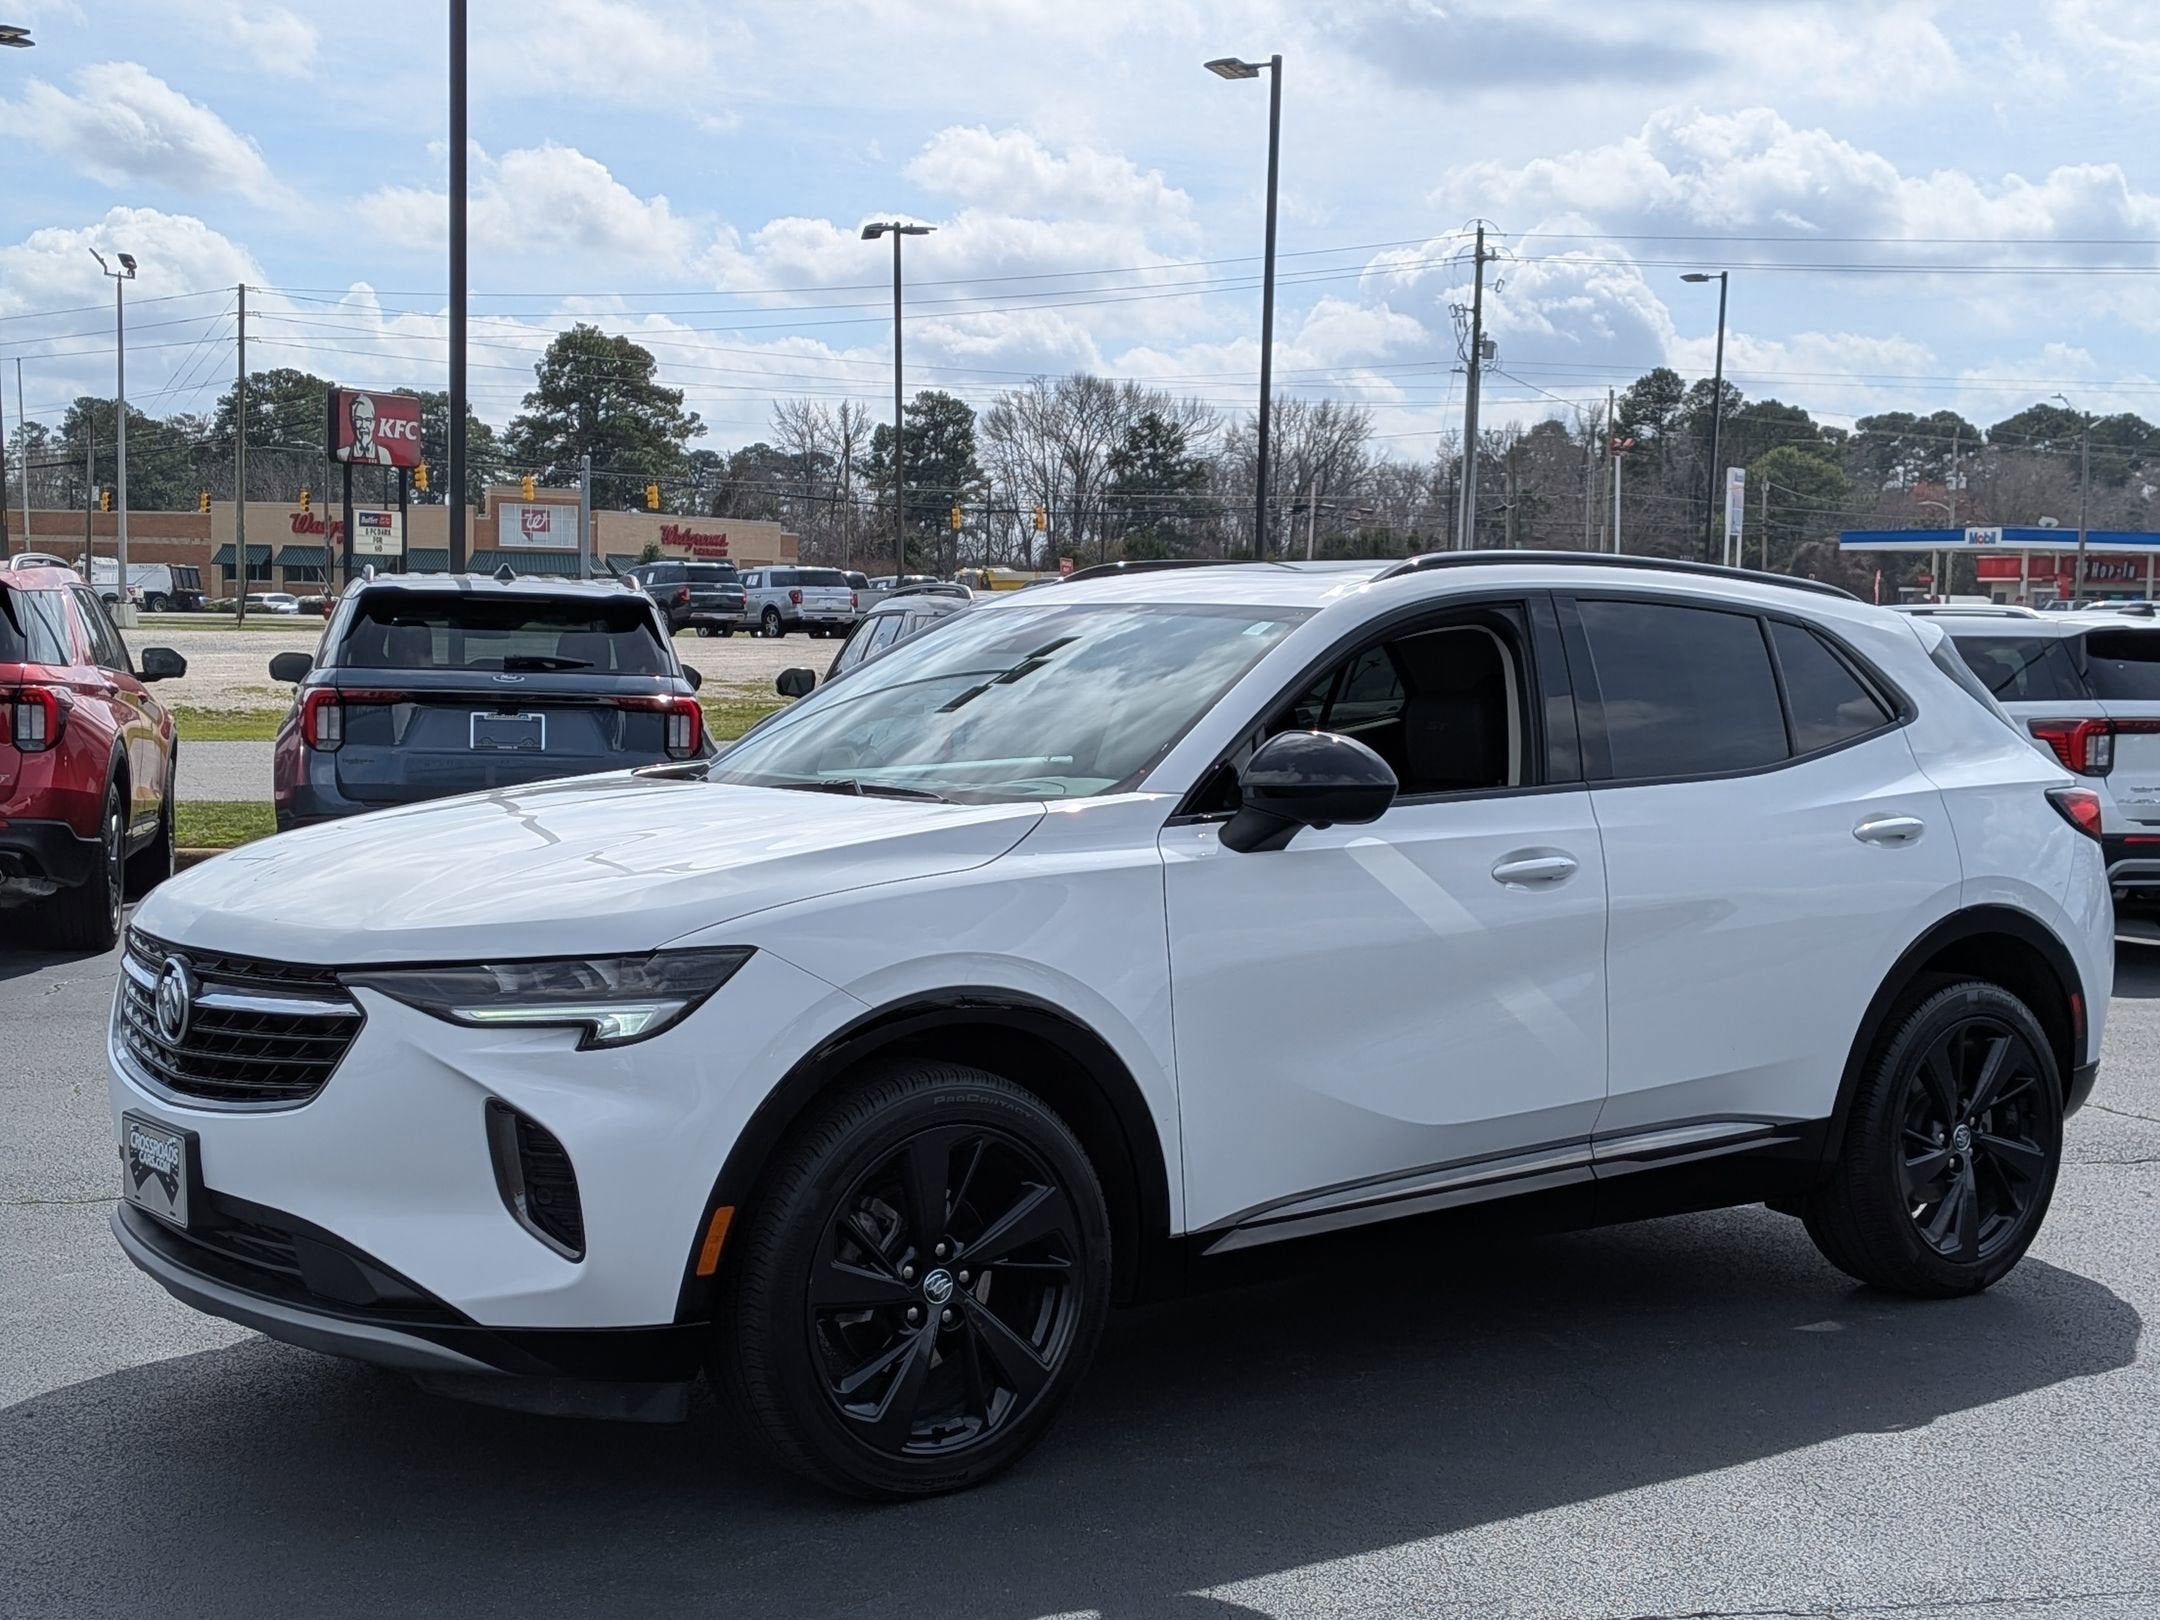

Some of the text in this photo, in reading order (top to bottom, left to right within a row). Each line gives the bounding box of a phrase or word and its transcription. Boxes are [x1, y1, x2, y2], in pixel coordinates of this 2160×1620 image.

[378, 417, 419, 441] KFC
[1969, 531, 1996, 545] Mobil
[130, 1131, 178, 1166] CROSSROADS
[138, 1150, 171, 1175] CARS.COM
